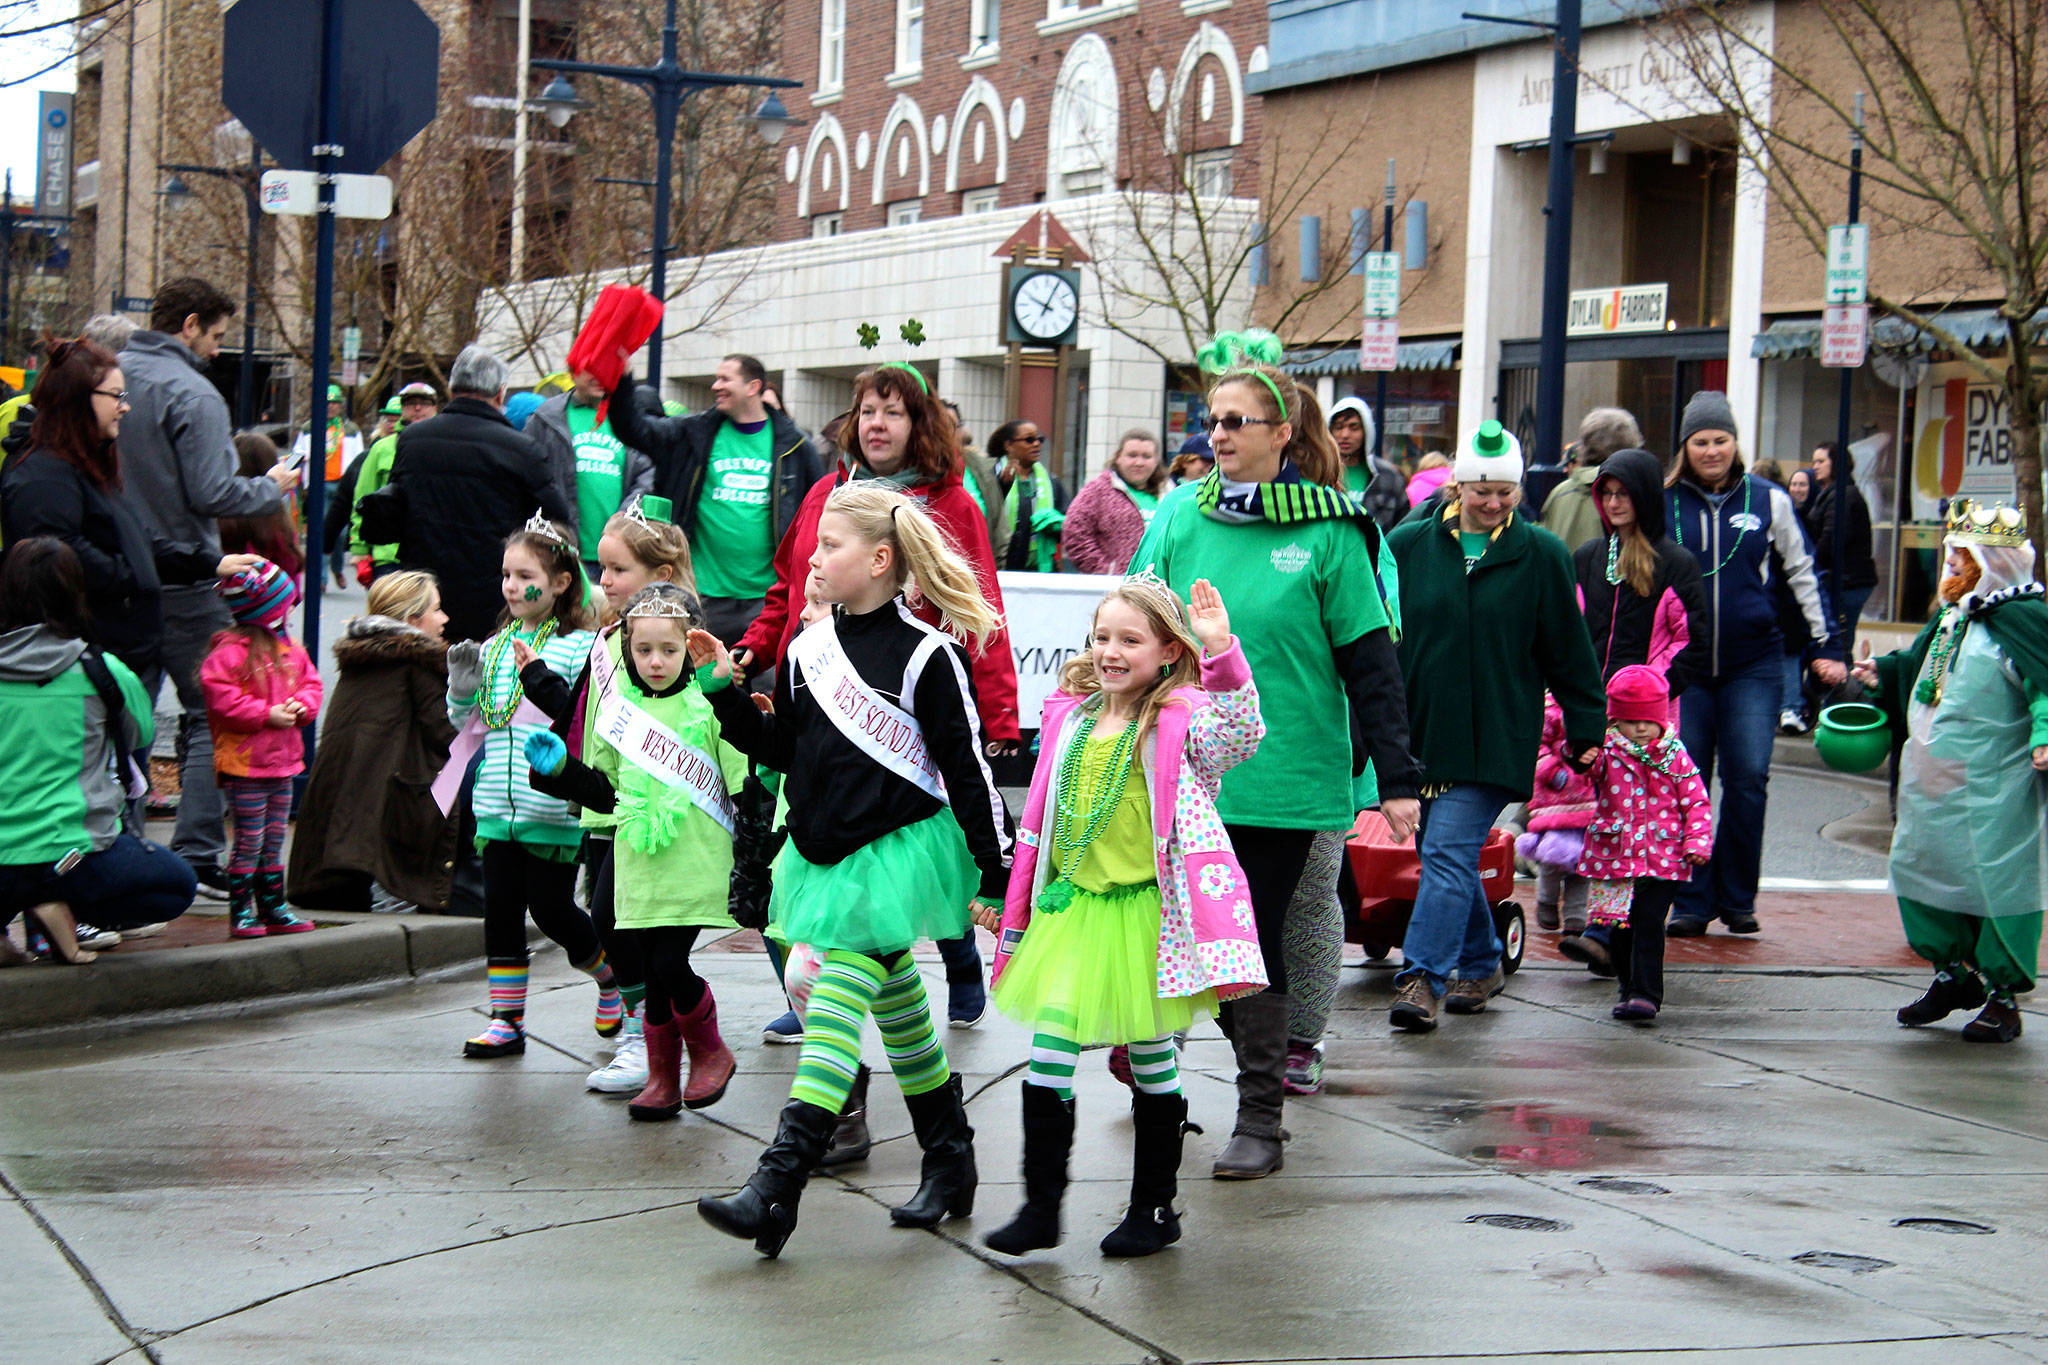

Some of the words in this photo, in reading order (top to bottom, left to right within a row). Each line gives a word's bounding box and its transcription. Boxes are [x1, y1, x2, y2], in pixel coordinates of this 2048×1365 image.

[46, 131, 65, 206] CHASE
[1569, 298, 1603, 327] DYLAN
[1620, 290, 1663, 324] FABRICS
[609, 704, 633, 743] 2017
[833, 674, 869, 720] WEST
[859, 704, 912, 754] SOUND
[641, 727, 679, 765] WEST
[670, 748, 714, 792] SOUND
